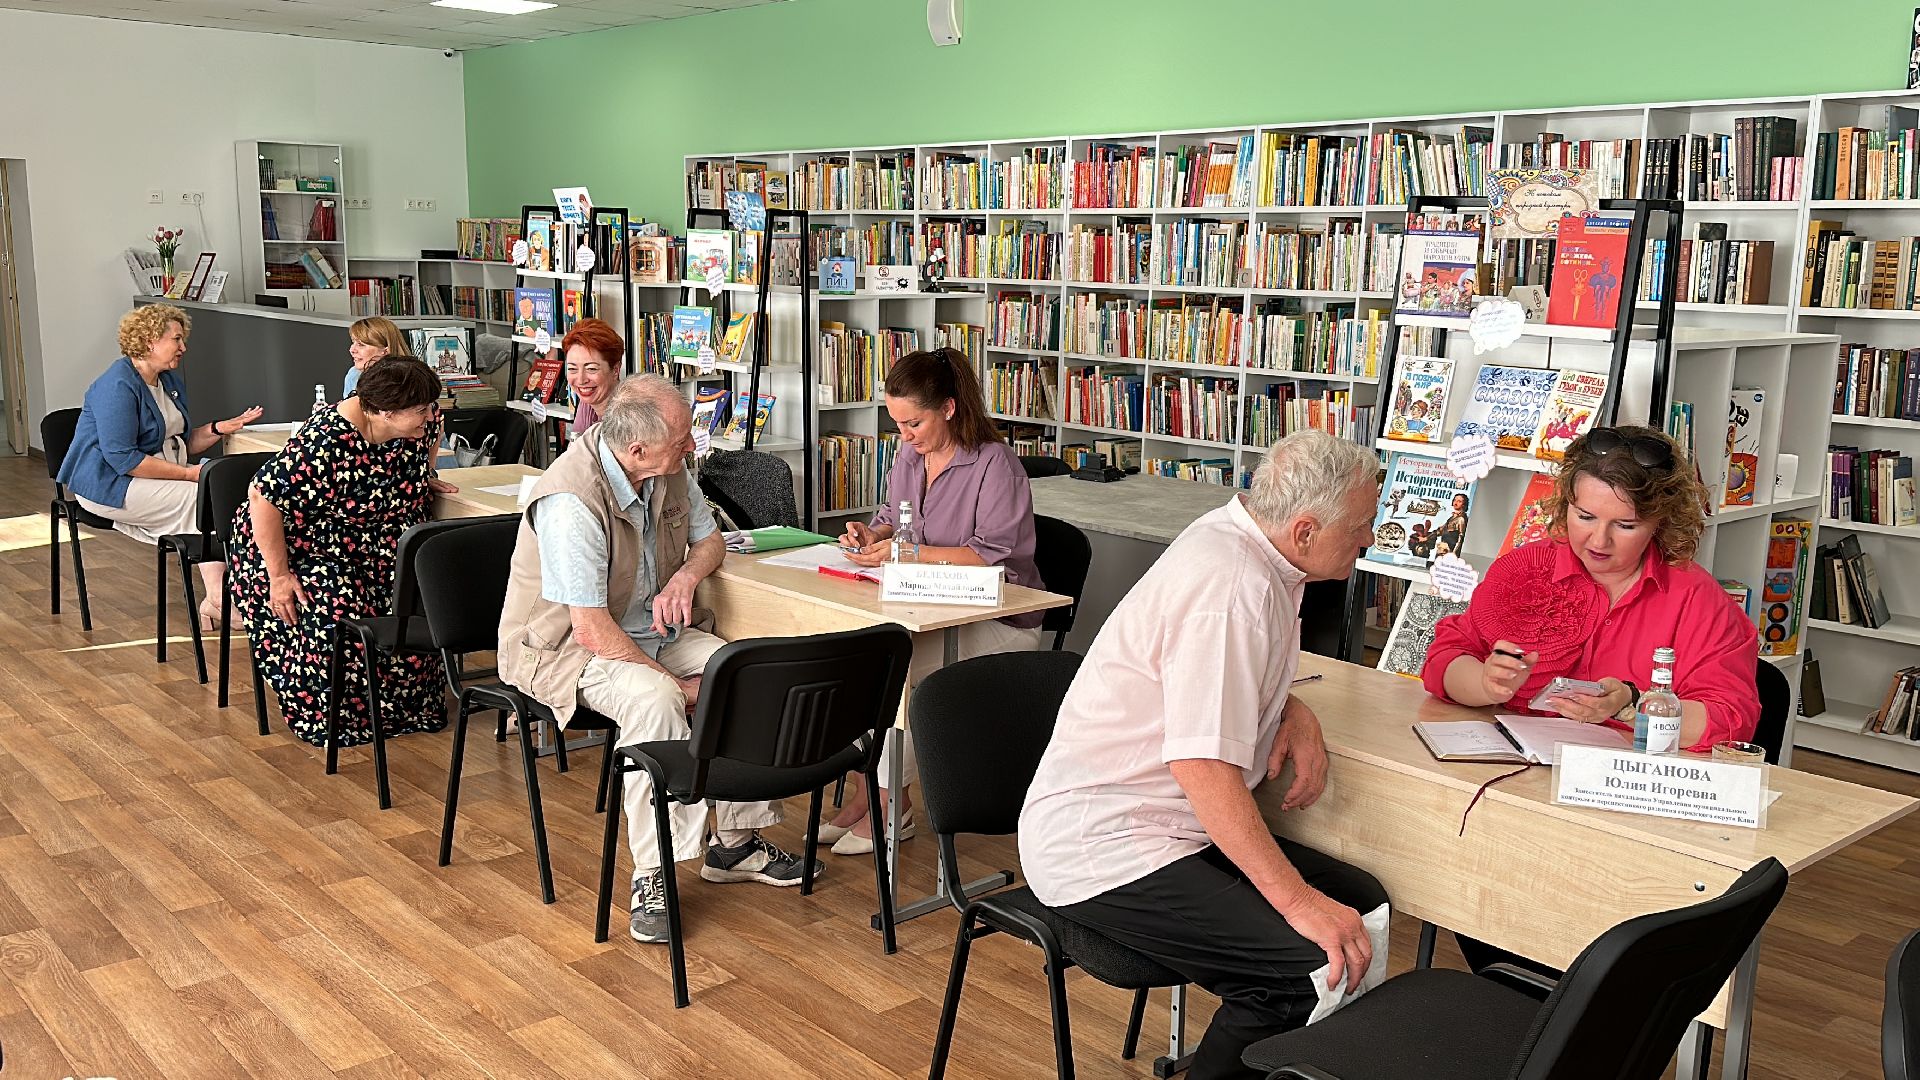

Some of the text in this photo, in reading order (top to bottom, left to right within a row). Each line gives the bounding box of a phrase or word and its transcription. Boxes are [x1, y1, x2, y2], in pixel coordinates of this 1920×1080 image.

[1405, 372, 1445, 384] Я ПОЗНАЮ
[1413, 381, 1432, 389] МИР
[1487, 405, 1541, 430] гжел
[1398, 457, 1433, 469] История
[1395, 470, 1470, 491] Историческя
[1407, 485, 1453, 500] картина
[1612, 758, 1712, 782] ЦЫГАНОВА
[1604, 776, 1717, 801] Юлия Игоревна
